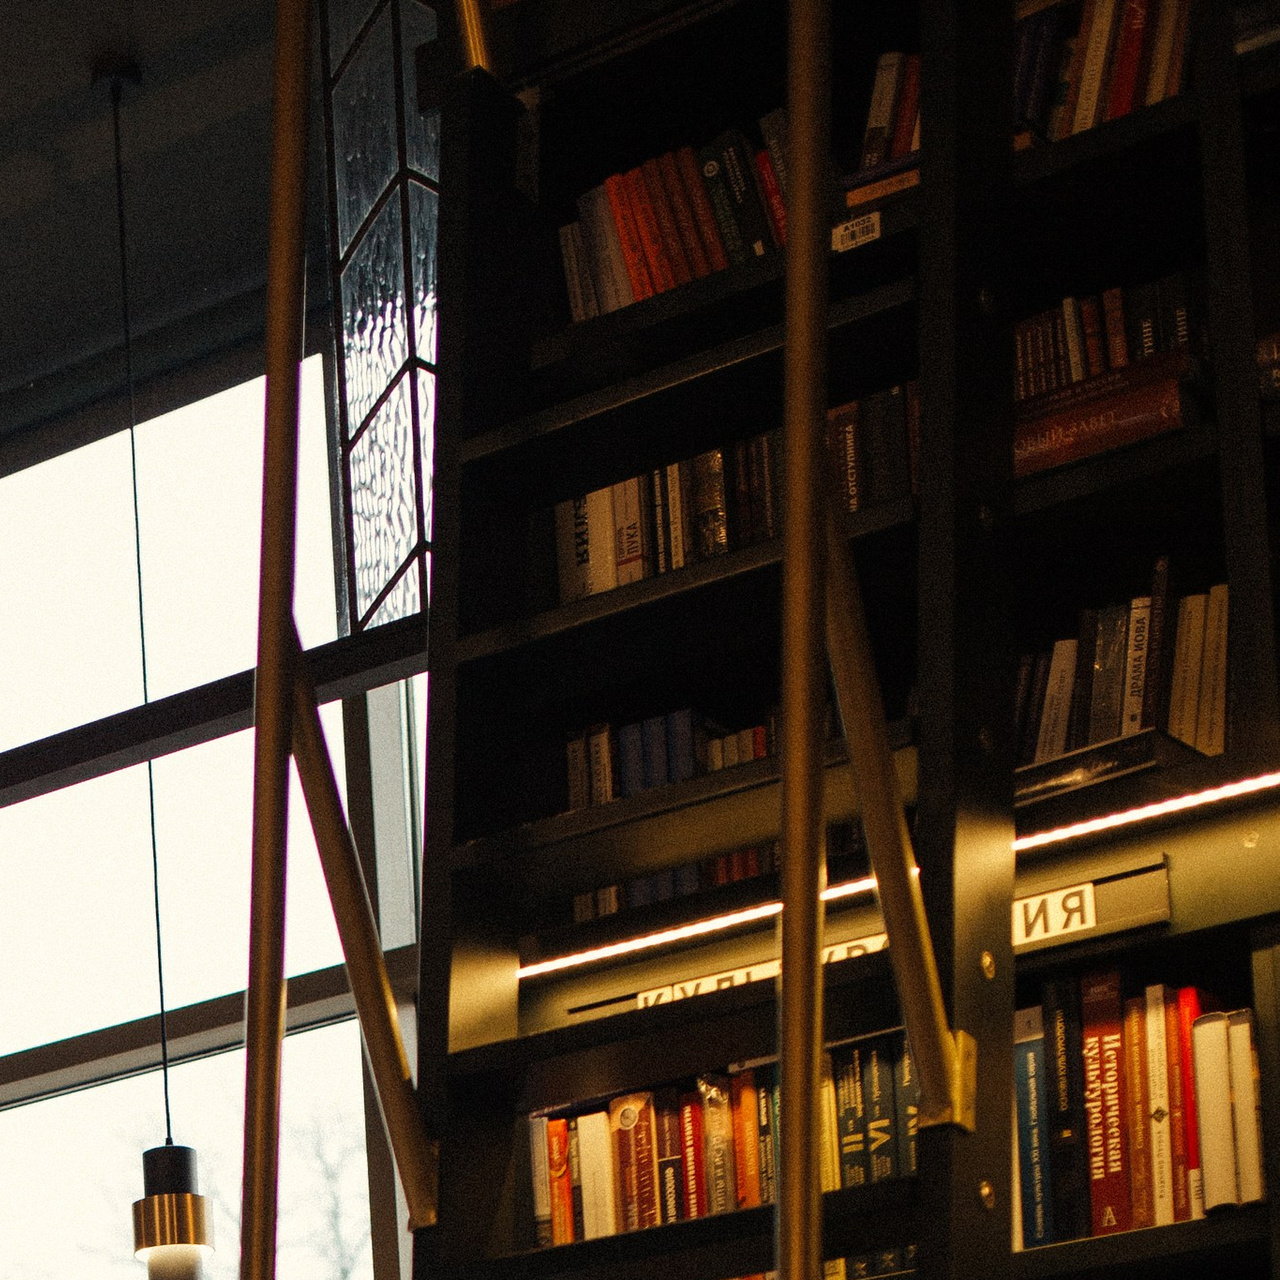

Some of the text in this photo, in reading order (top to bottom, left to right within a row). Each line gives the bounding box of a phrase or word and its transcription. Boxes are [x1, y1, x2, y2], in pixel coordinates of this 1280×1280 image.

[845, 424, 859, 495] ОТСТУПНИКА
[1131, 616, 1147, 698] ДРАМА ИОВА
[868, 1118, 891, 1151] VI
[1082, 1035, 1106, 1180] культурология
[1102, 1032, 1122, 1173] Историческая
